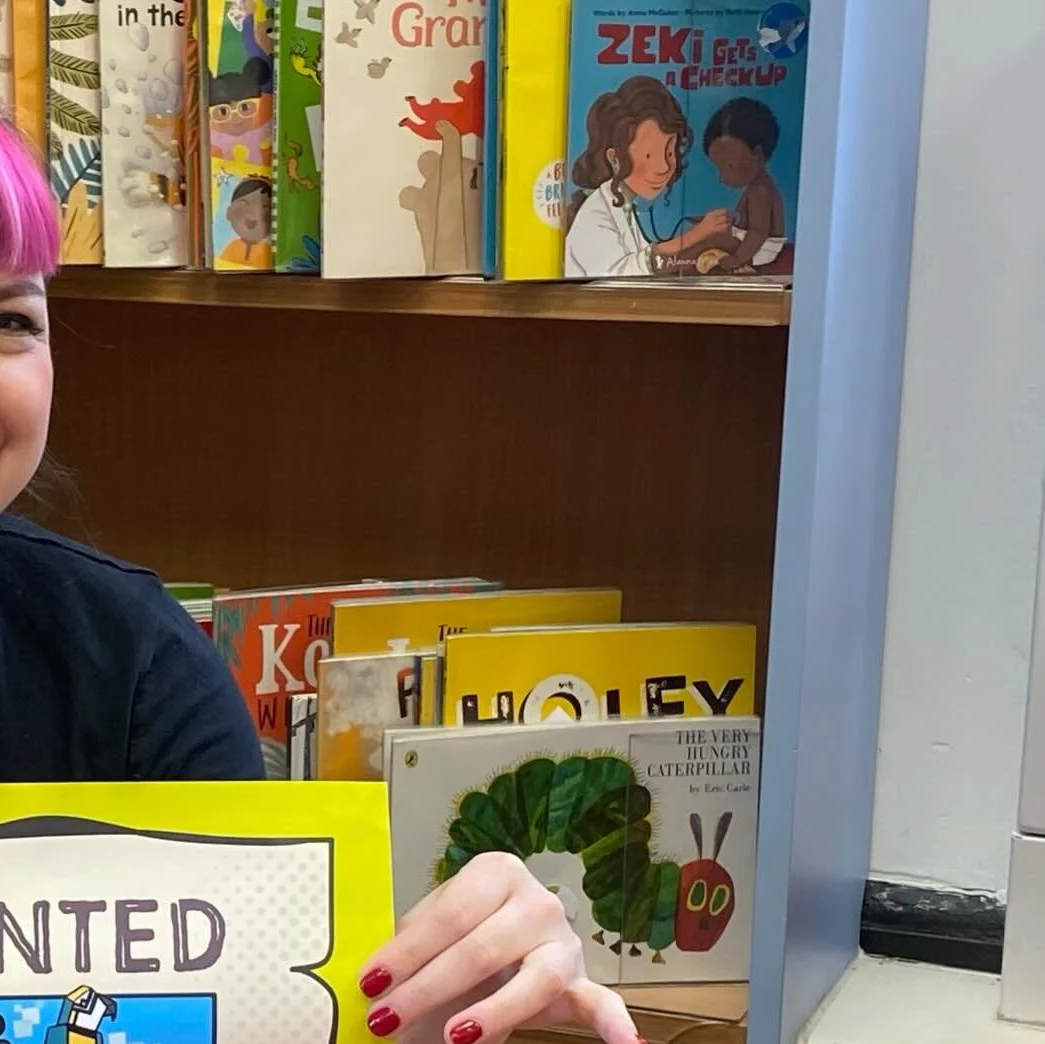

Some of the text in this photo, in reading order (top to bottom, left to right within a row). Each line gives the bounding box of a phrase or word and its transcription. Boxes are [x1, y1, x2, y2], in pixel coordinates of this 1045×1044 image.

[117, 2, 185, 27] in the
[679, 63, 788, 91] CHECKUP
[676, 728, 751, 745] THE VERY
[686, 745, 750, 760] HUNGRY
[647, 761, 752, 778] CATERPILLAR
[689, 782, 751, 794] by Eric Carle
